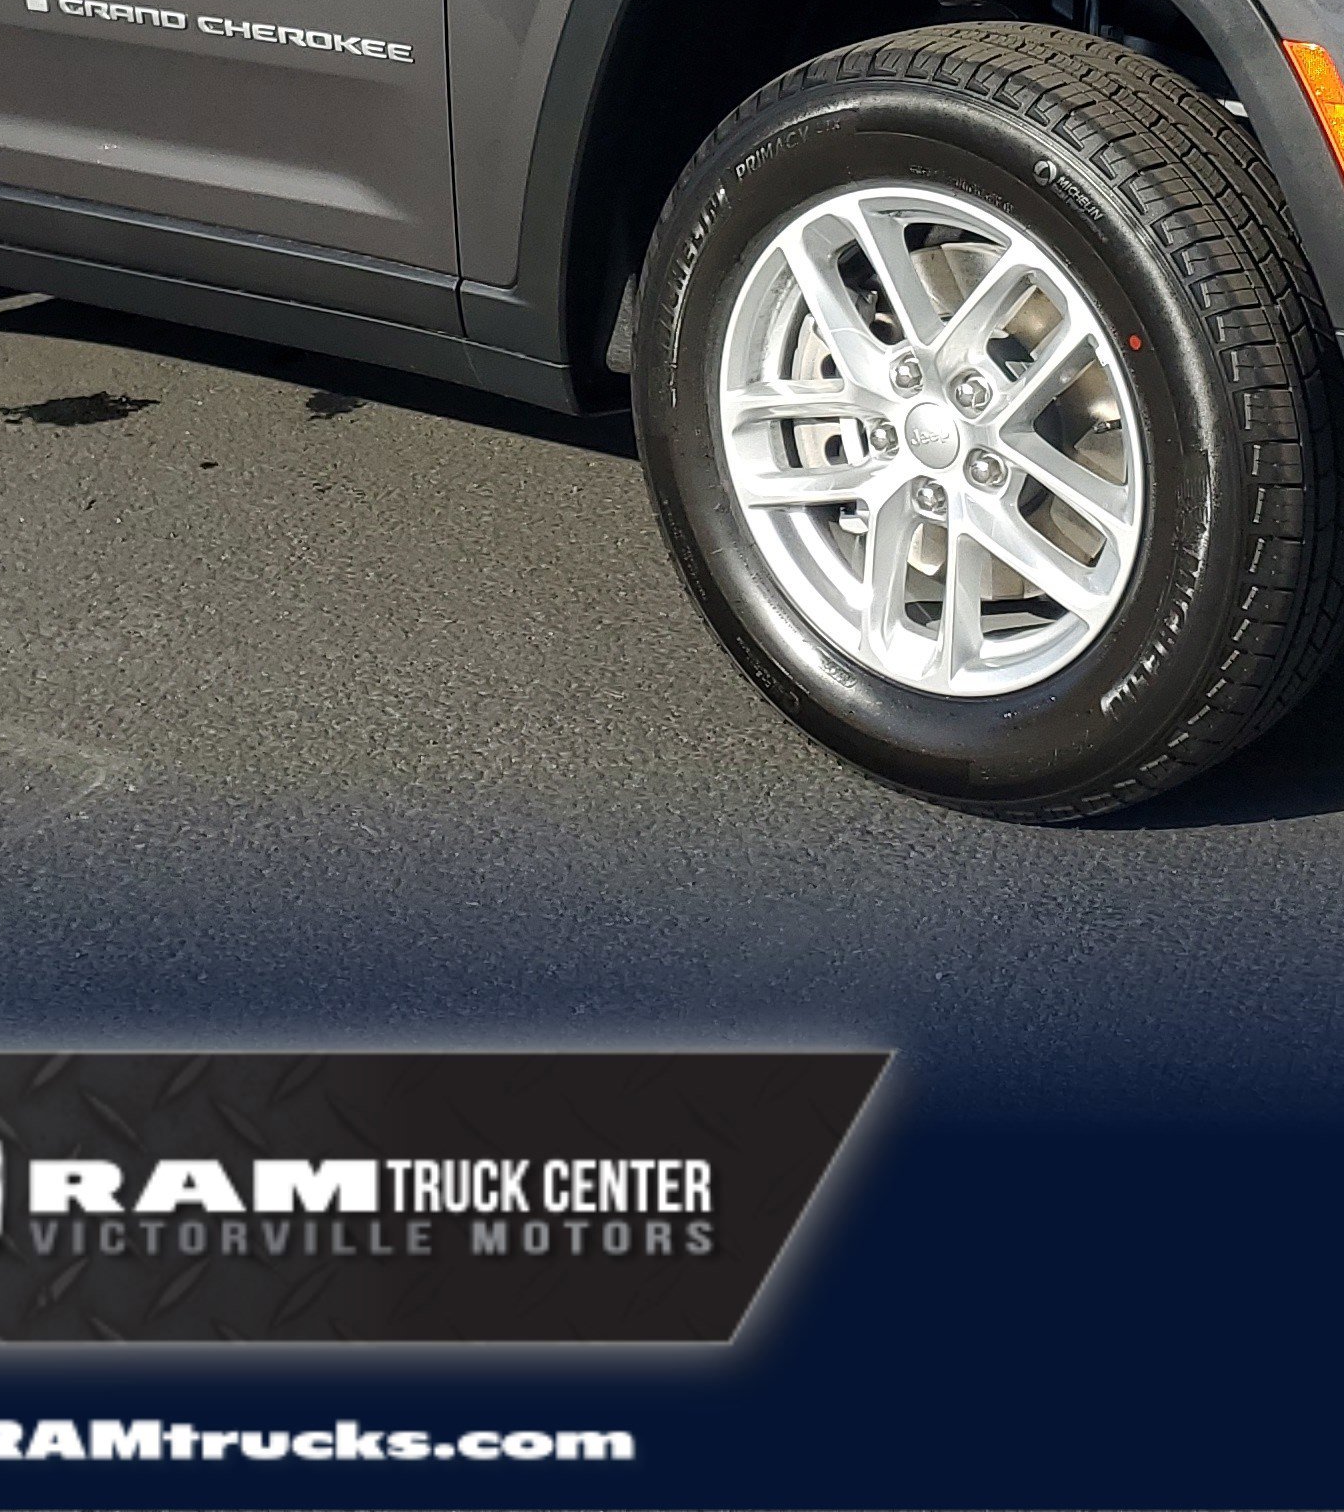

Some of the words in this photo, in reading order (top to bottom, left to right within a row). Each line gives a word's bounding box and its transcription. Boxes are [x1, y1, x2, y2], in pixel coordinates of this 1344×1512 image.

[197, 16, 414, 64] CHEROKEE
[733, 125, 810, 182] PRIMACY
[1056, 175, 1104, 221] MICHELIN
